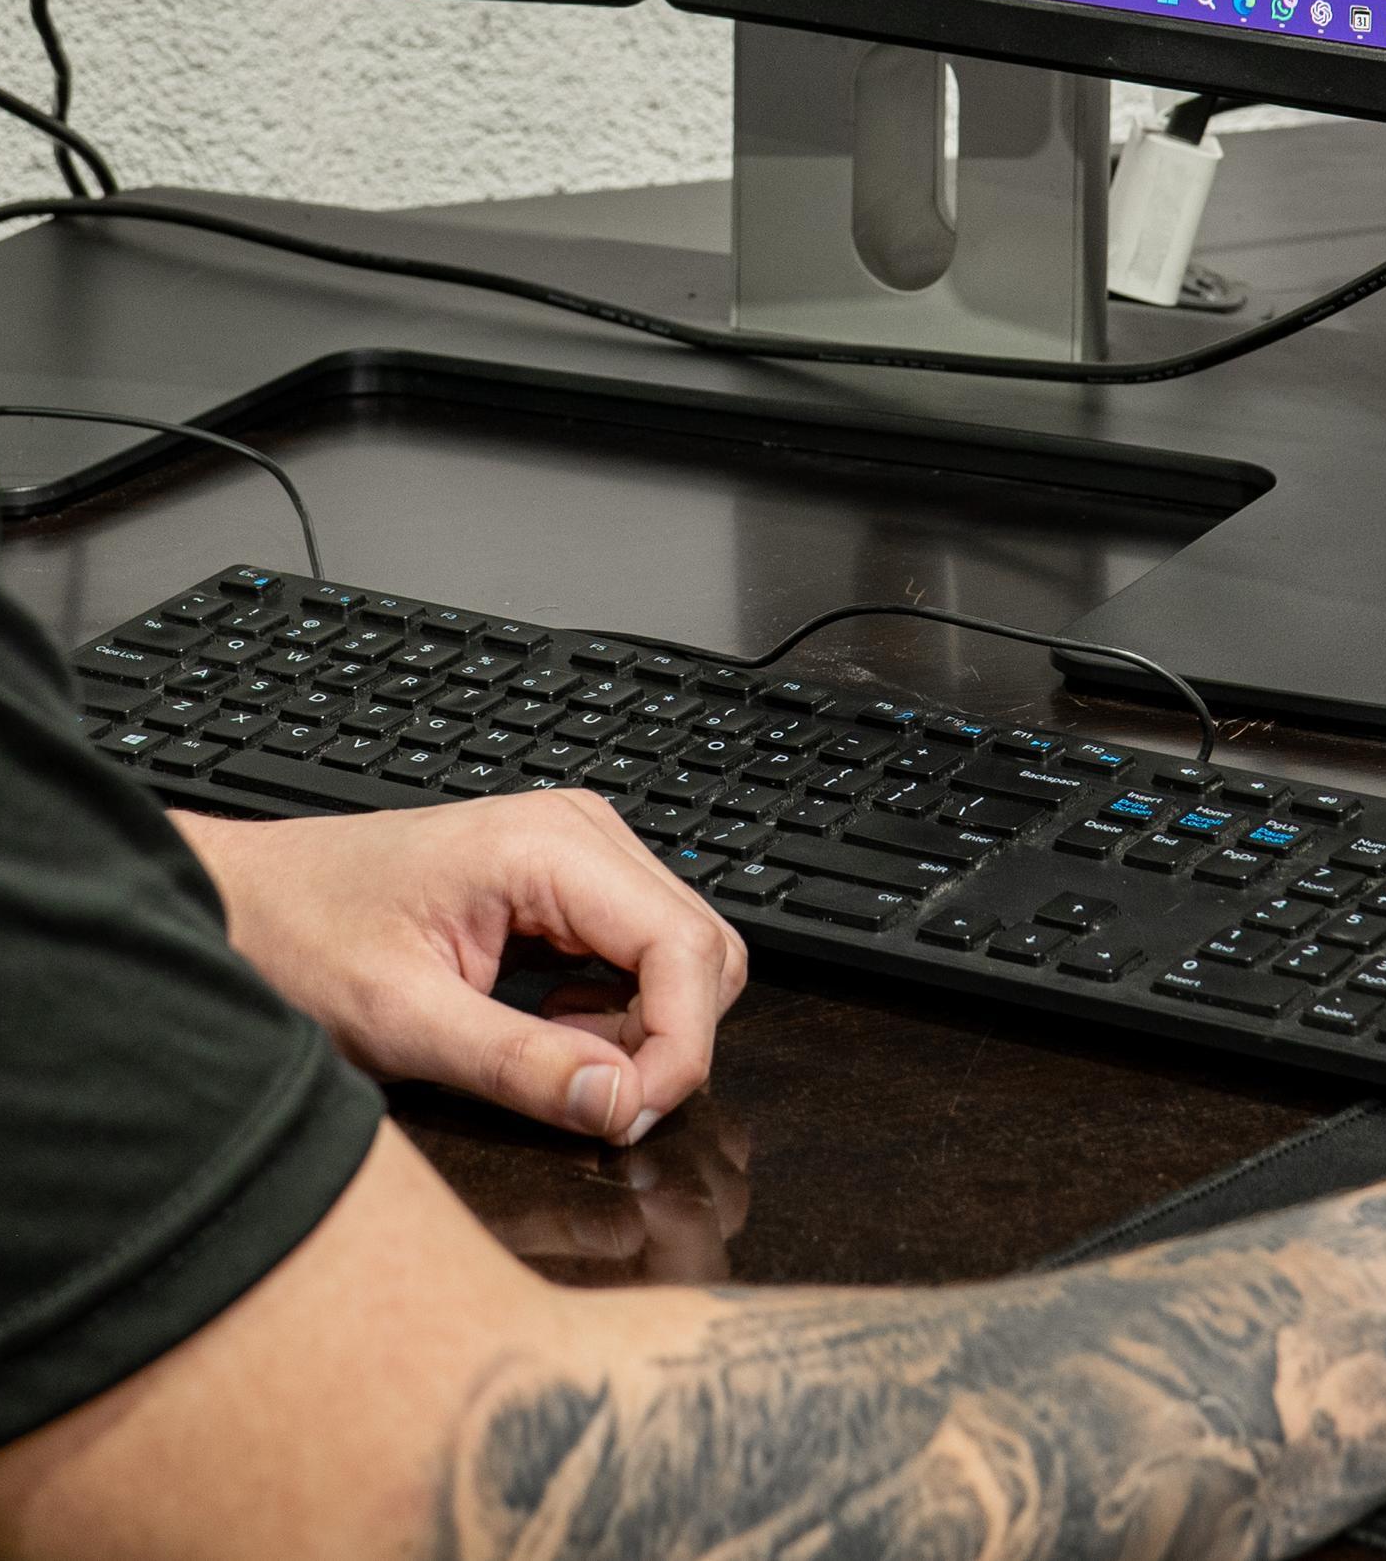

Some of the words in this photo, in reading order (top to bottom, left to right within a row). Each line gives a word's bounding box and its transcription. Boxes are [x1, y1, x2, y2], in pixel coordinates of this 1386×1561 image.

[1356, 16, 1367, 27] 31
[145, 619, 161, 629] Tab
[96, 646, 119, 659] Caps
[120, 651, 144, 660] Lock
[1020, 770, 1080, 786] Backspace
[1127, 791, 1162, 804] Insert
[1111, 804, 1153, 816] Screen
[1118, 799, 1148, 811] Print
[1197, 805, 1232, 819] Home
[1179, 818, 1210, 829] Lock
[1186, 812, 1223, 826] Scroll
[1085, 820, 1122, 833] Delete
[1266, 819, 1299, 833] PgUp
[960, 833, 993, 844] Enter
[1250, 832, 1286, 845] Break
[1256, 827, 1294, 840] Pause
[1153, 834, 1178, 846] End
[1223, 848, 1257, 863] PgDn
[1351, 844, 1380, 855] Lock
[918, 862, 948, 873] Shift
[878, 893, 902, 903] Ctrl
